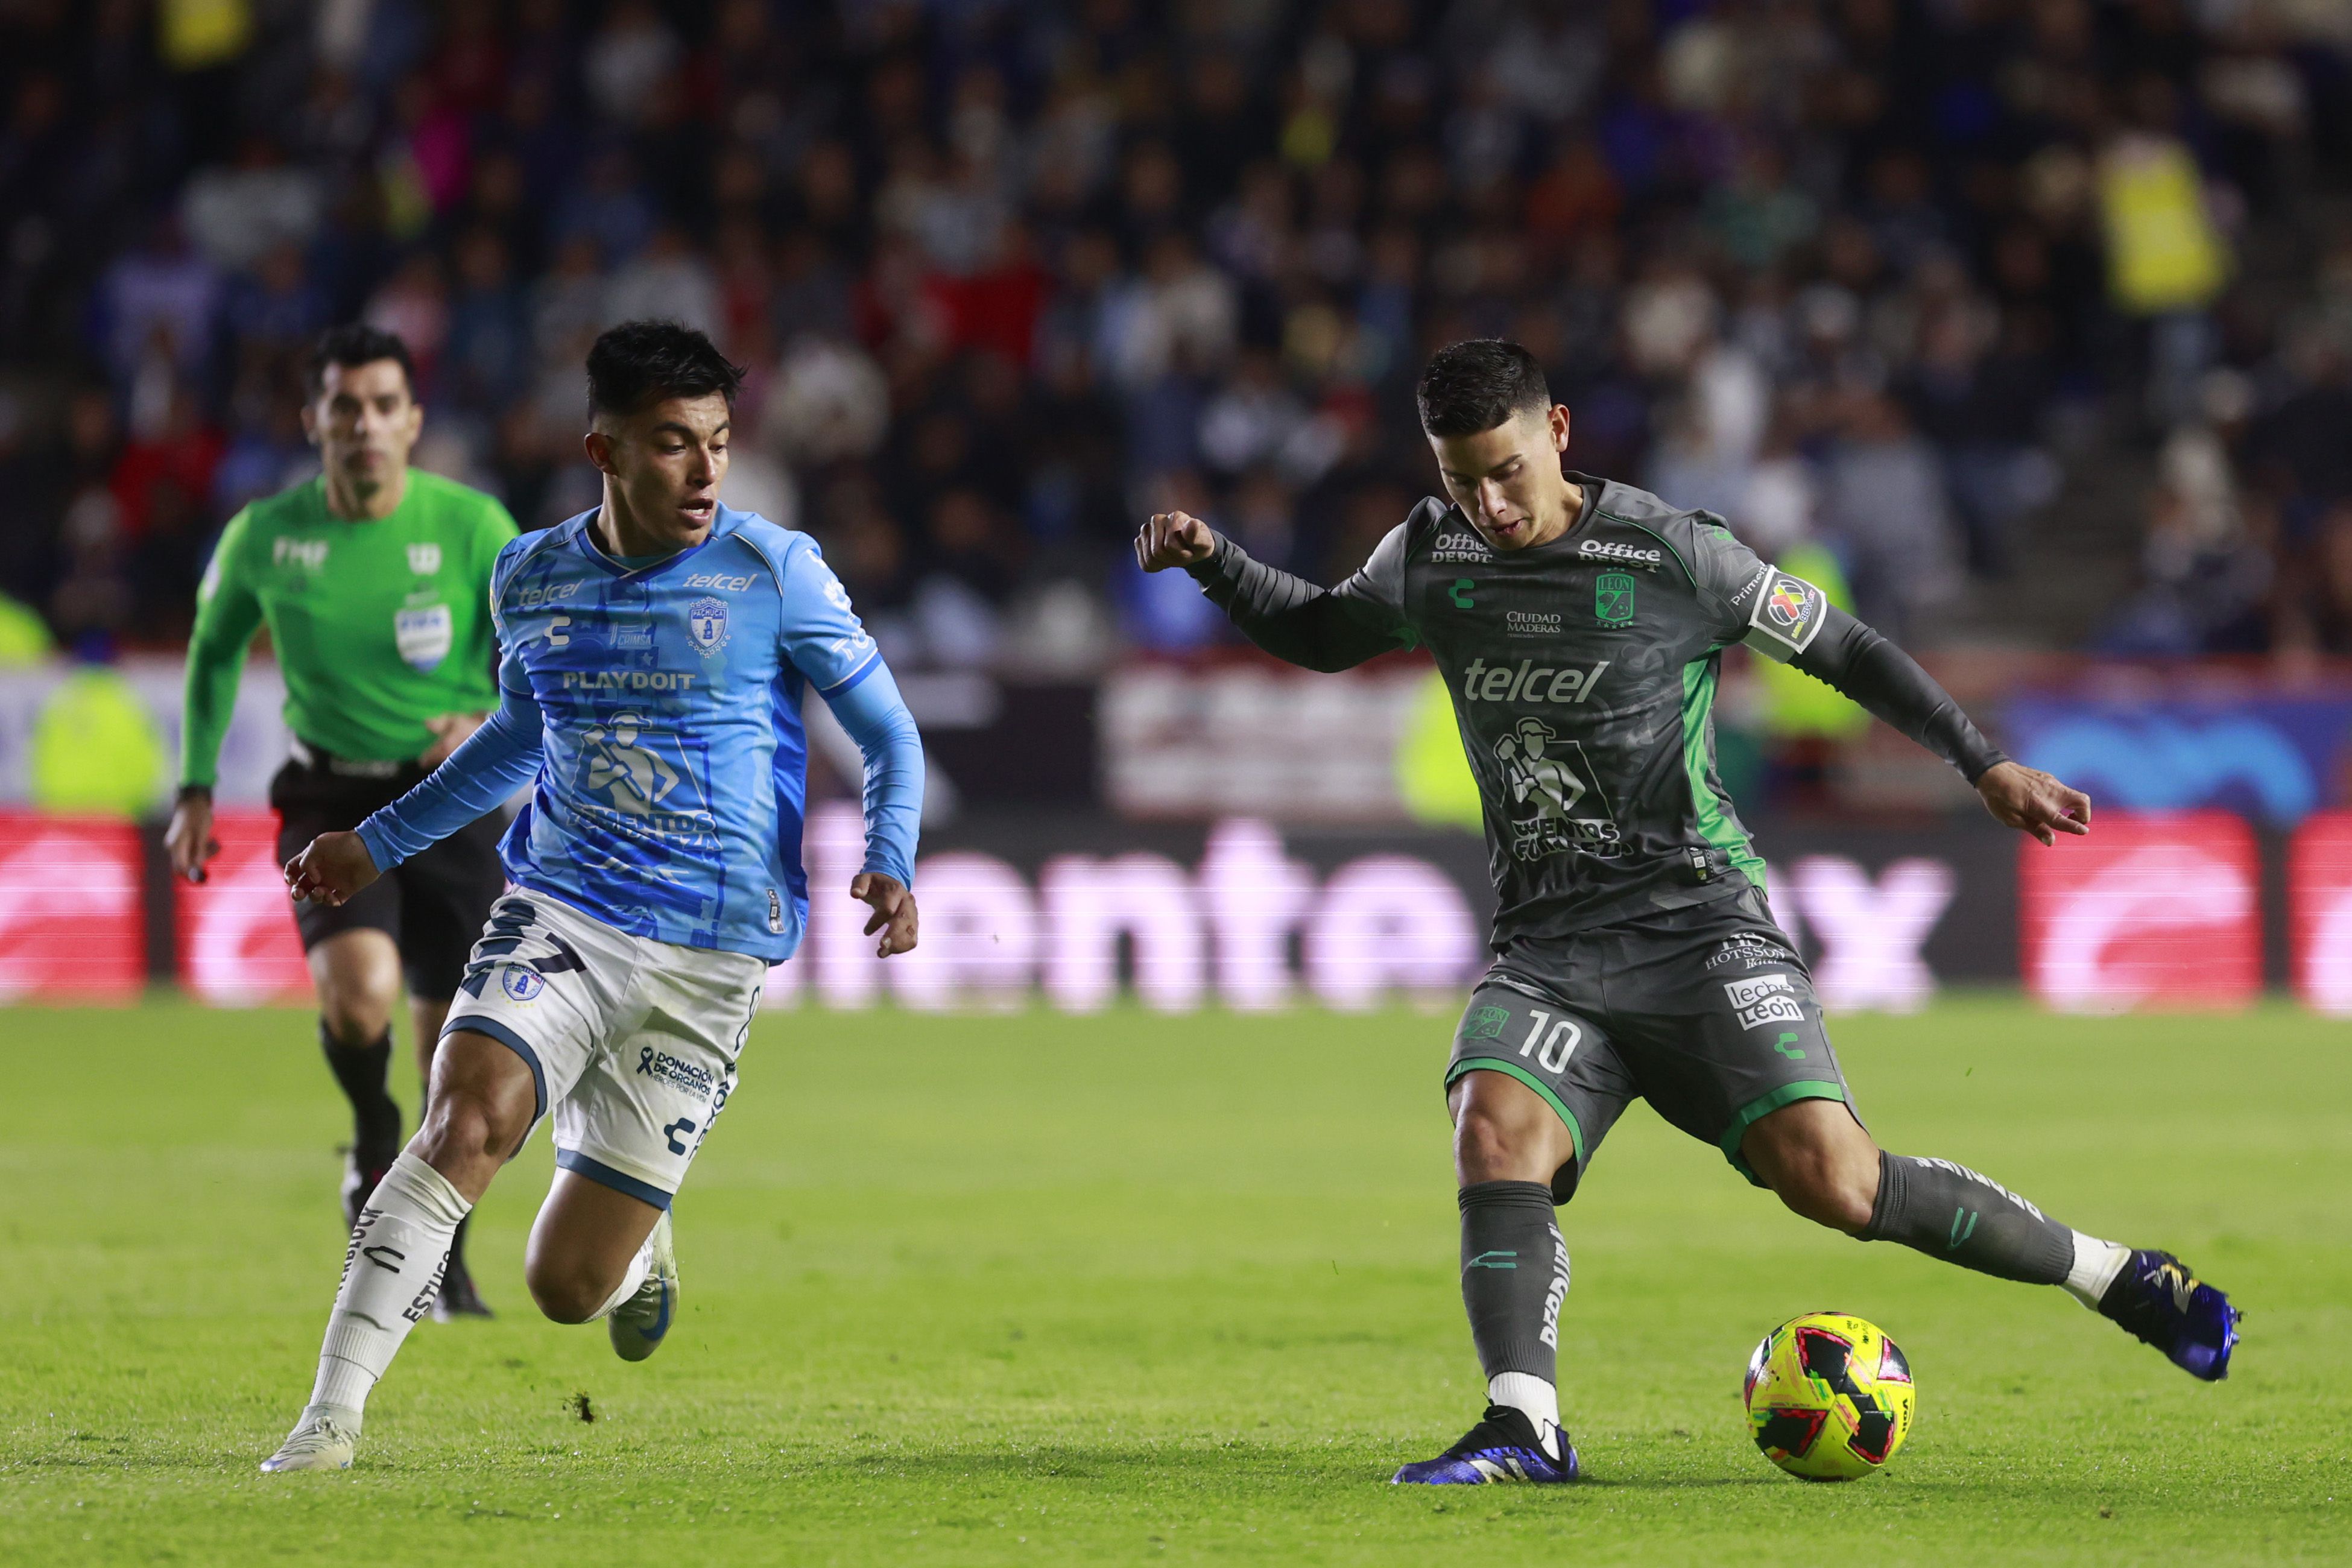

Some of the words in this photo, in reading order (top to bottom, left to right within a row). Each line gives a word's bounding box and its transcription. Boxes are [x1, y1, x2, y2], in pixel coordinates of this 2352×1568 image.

[1435, 533, 1489, 552] Offi
[1580, 539, 1661, 563] Office
[1431, 551, 1493, 564] DEPOT
[519, 578, 586, 607] telcel
[682, 573, 758, 592] telcel
[693, 608, 724, 617] PACHUCA
[1506, 611, 1561, 624] CIUDAD
[1799, 599, 1815, 623] BBVA
[1507, 623, 1561, 634] MADERAS
[562, 671, 696, 691] PLAYDOIT
[1464, 657, 1611, 704] telcel
[1705, 947, 1786, 972] HOTSSON
[1730, 981, 1791, 1006] leche
[1743, 997, 1800, 1026] León
[1519, 1009, 1582, 1075] 10
[653, 1062, 669, 1075] DE
[669, 1070, 712, 1096] ORGANOS
[656, 1051, 715, 1085] DONACIÓN
